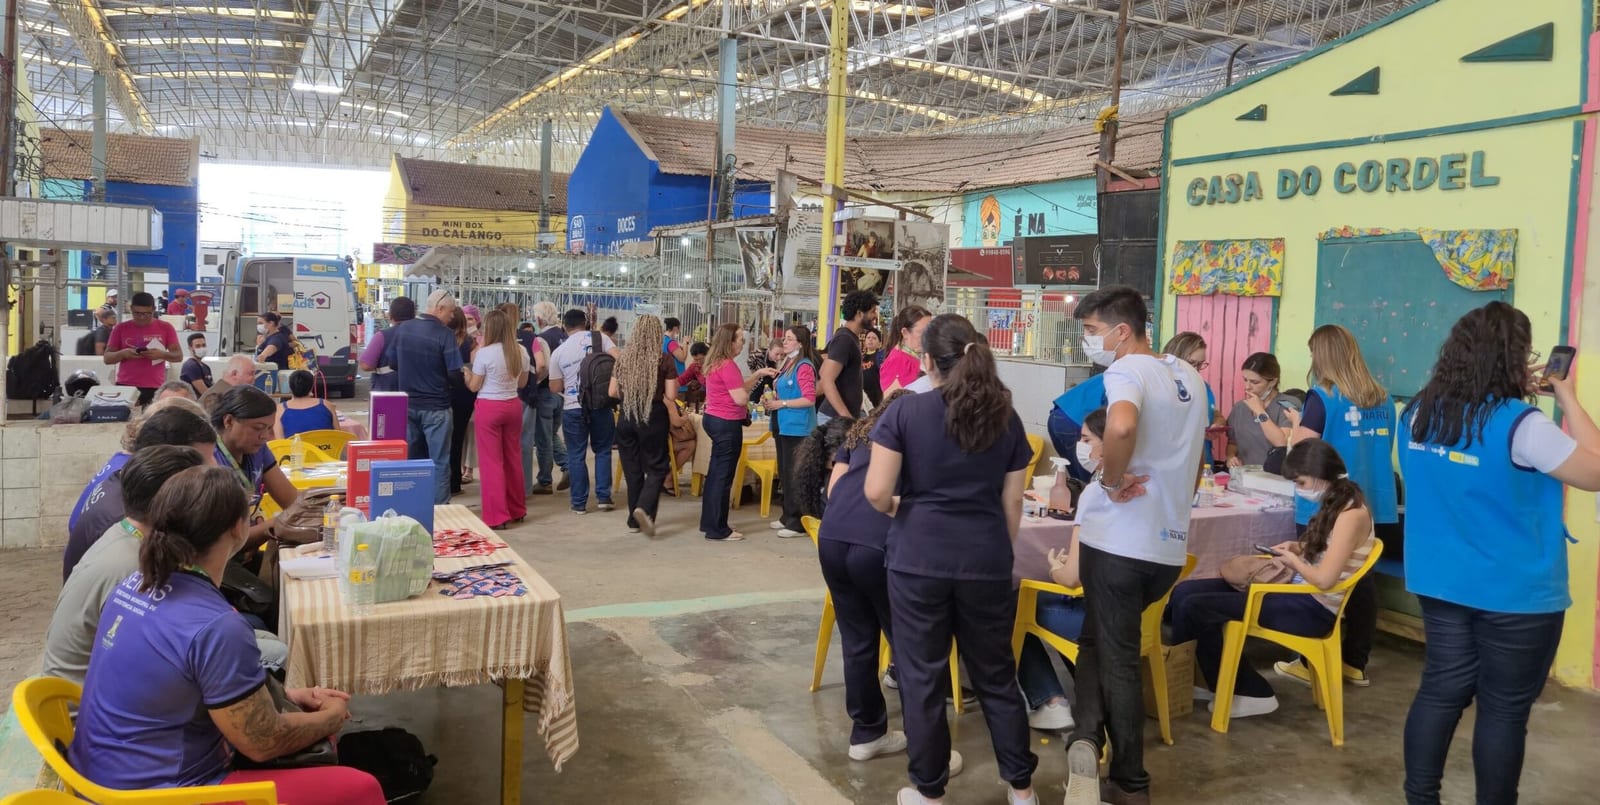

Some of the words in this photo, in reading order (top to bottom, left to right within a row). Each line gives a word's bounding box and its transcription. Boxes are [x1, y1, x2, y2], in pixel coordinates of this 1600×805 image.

[1186, 171, 1264, 207] CASA
[1276, 165, 1322, 200] DO
[1333, 150, 1501, 194] CORDEL
[442, 220, 462, 228] MINI
[465, 221, 484, 229] BOX
[616, 215, 636, 234] DOCES
[1014, 207, 1023, 237] É
[1027, 212, 1046, 236] NA
[422, 227, 439, 237] DO
[443, 228, 502, 240] CALANGO
